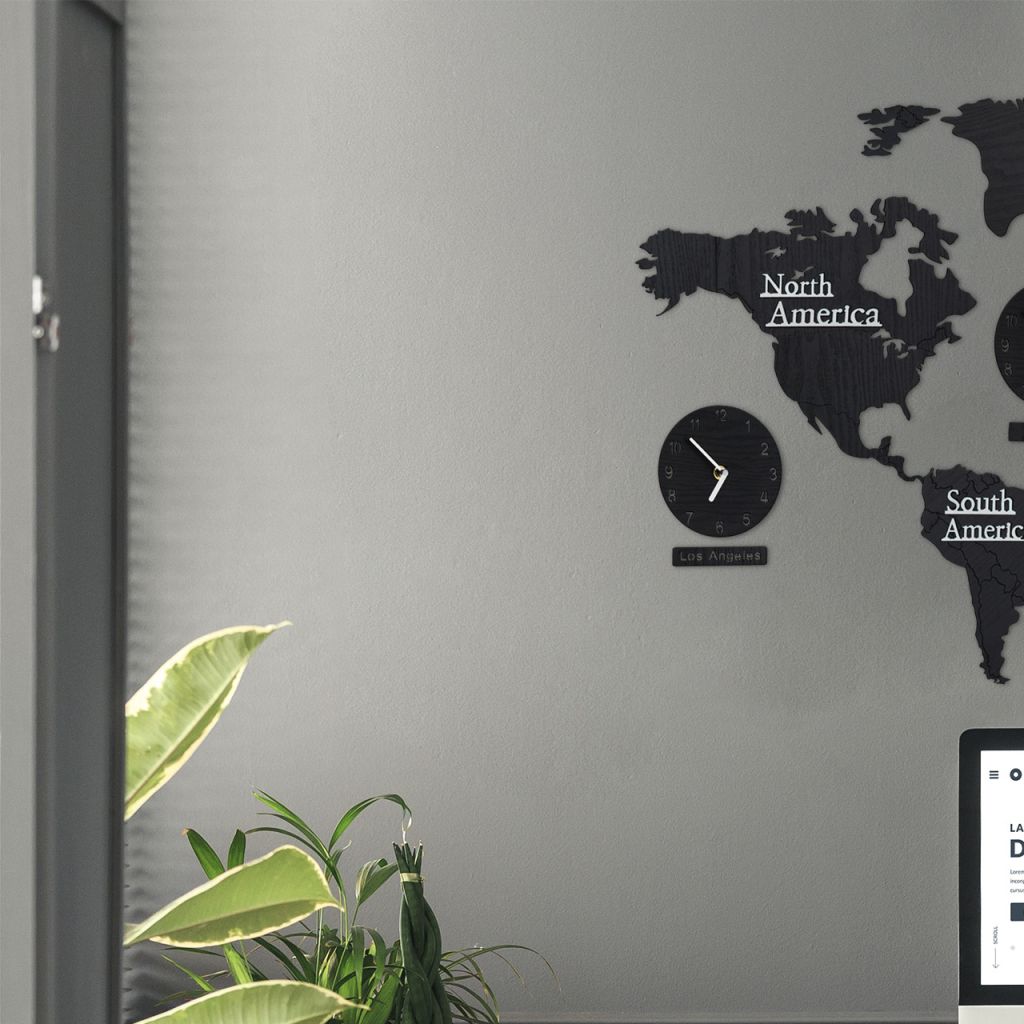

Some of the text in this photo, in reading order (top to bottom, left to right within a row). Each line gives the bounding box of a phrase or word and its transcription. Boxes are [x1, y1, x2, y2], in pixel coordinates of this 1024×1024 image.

[760, 273, 834, 297] North
[765, 301, 882, 327] America
[1006, 315, 1017, 328] 10
[1001, 339, 1009, 352] 9
[1005, 363, 1012, 376] 8
[715, 409, 727, 422] 12
[690, 418, 700, 431] 11
[746, 420, 750, 432] 1
[670, 441, 681, 455] 10
[761, 443, 768, 456] 2
[665, 466, 672, 479] 9
[770, 468, 777, 480] 3
[668, 489, 676, 502] 8
[760, 491, 768, 503] 4
[945, 489, 1016, 515] South
[686, 512, 693, 525] 7
[716, 521, 723, 534] 6
[680, 551, 761, 563] Los Angeles
